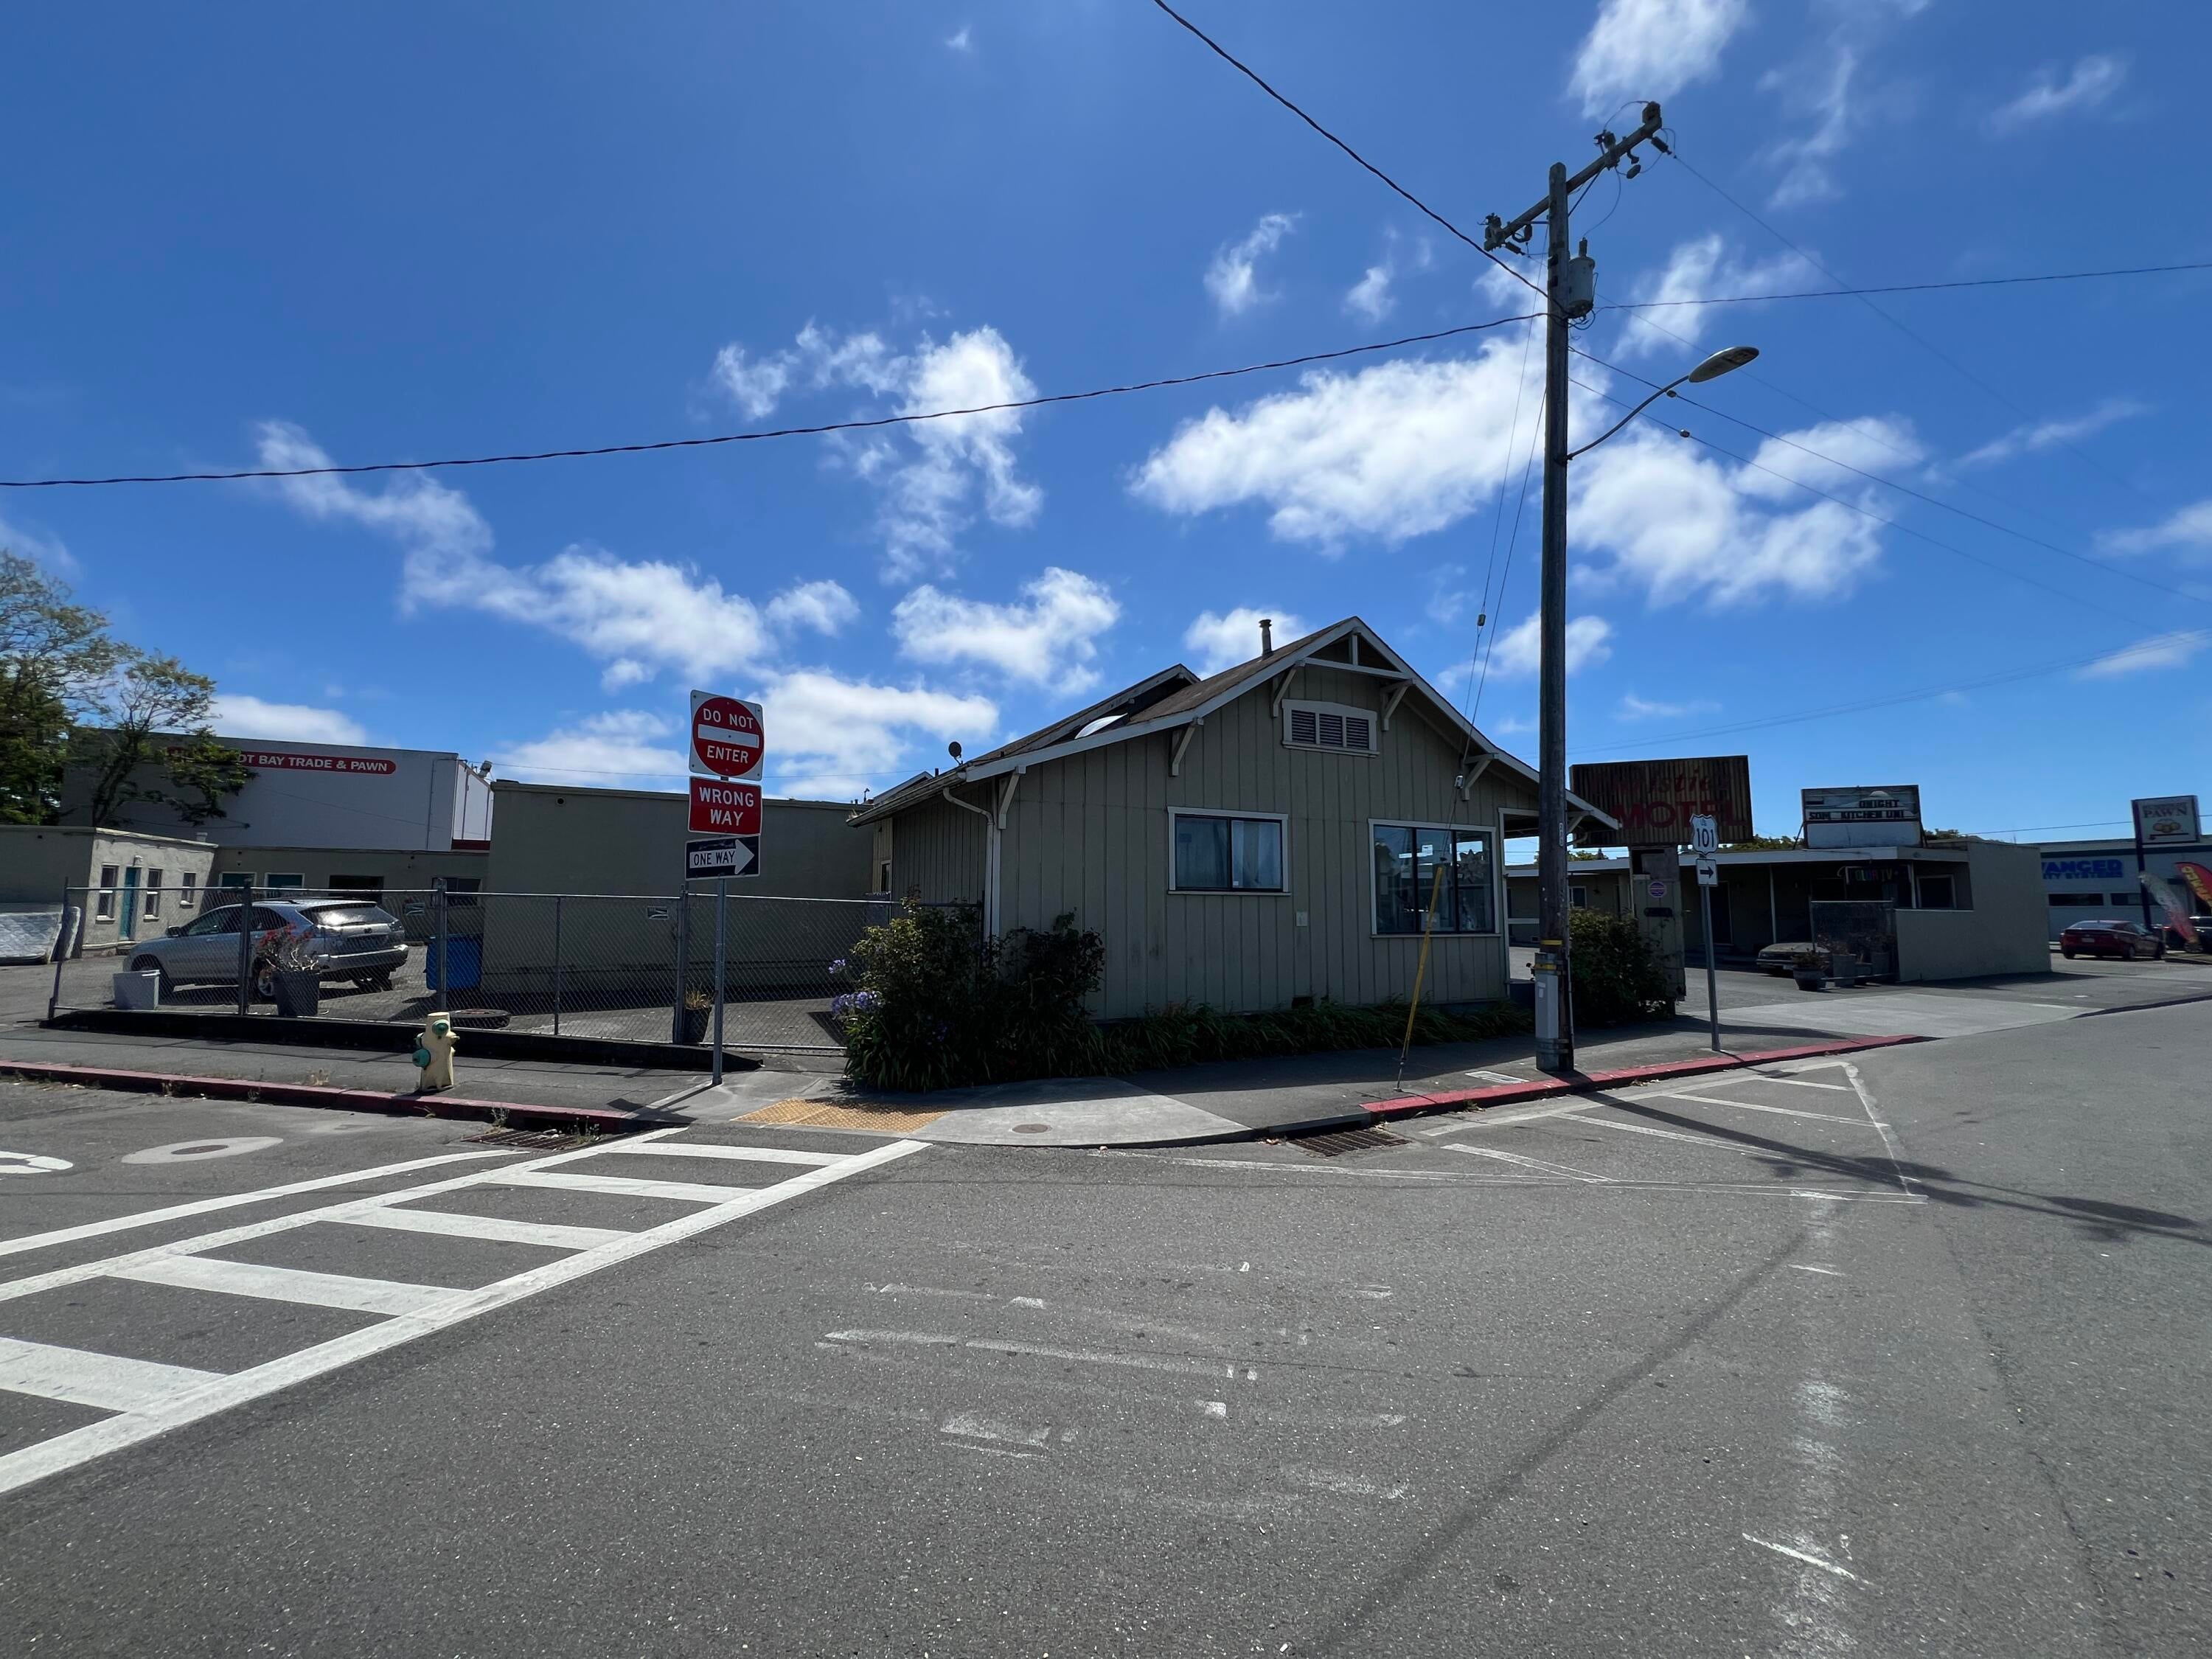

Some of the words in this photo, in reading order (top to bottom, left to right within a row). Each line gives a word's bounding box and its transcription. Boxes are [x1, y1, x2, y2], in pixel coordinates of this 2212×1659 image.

[703, 708, 721, 723] DO
[729, 713, 754, 729] NOT
[259, 755, 285, 766] BAY
[288, 757, 333, 768] TRADE
[336, 760, 347, 769] &
[351, 761, 388, 772] PAWN
[706, 745, 748, 764] ENTER
[699, 787, 754, 807] WRONG
[710, 809, 744, 827] WAY
[1697, 827, 1714, 848] 101
[693, 852, 712, 866] ONE
[715, 850, 735, 864] WAY
